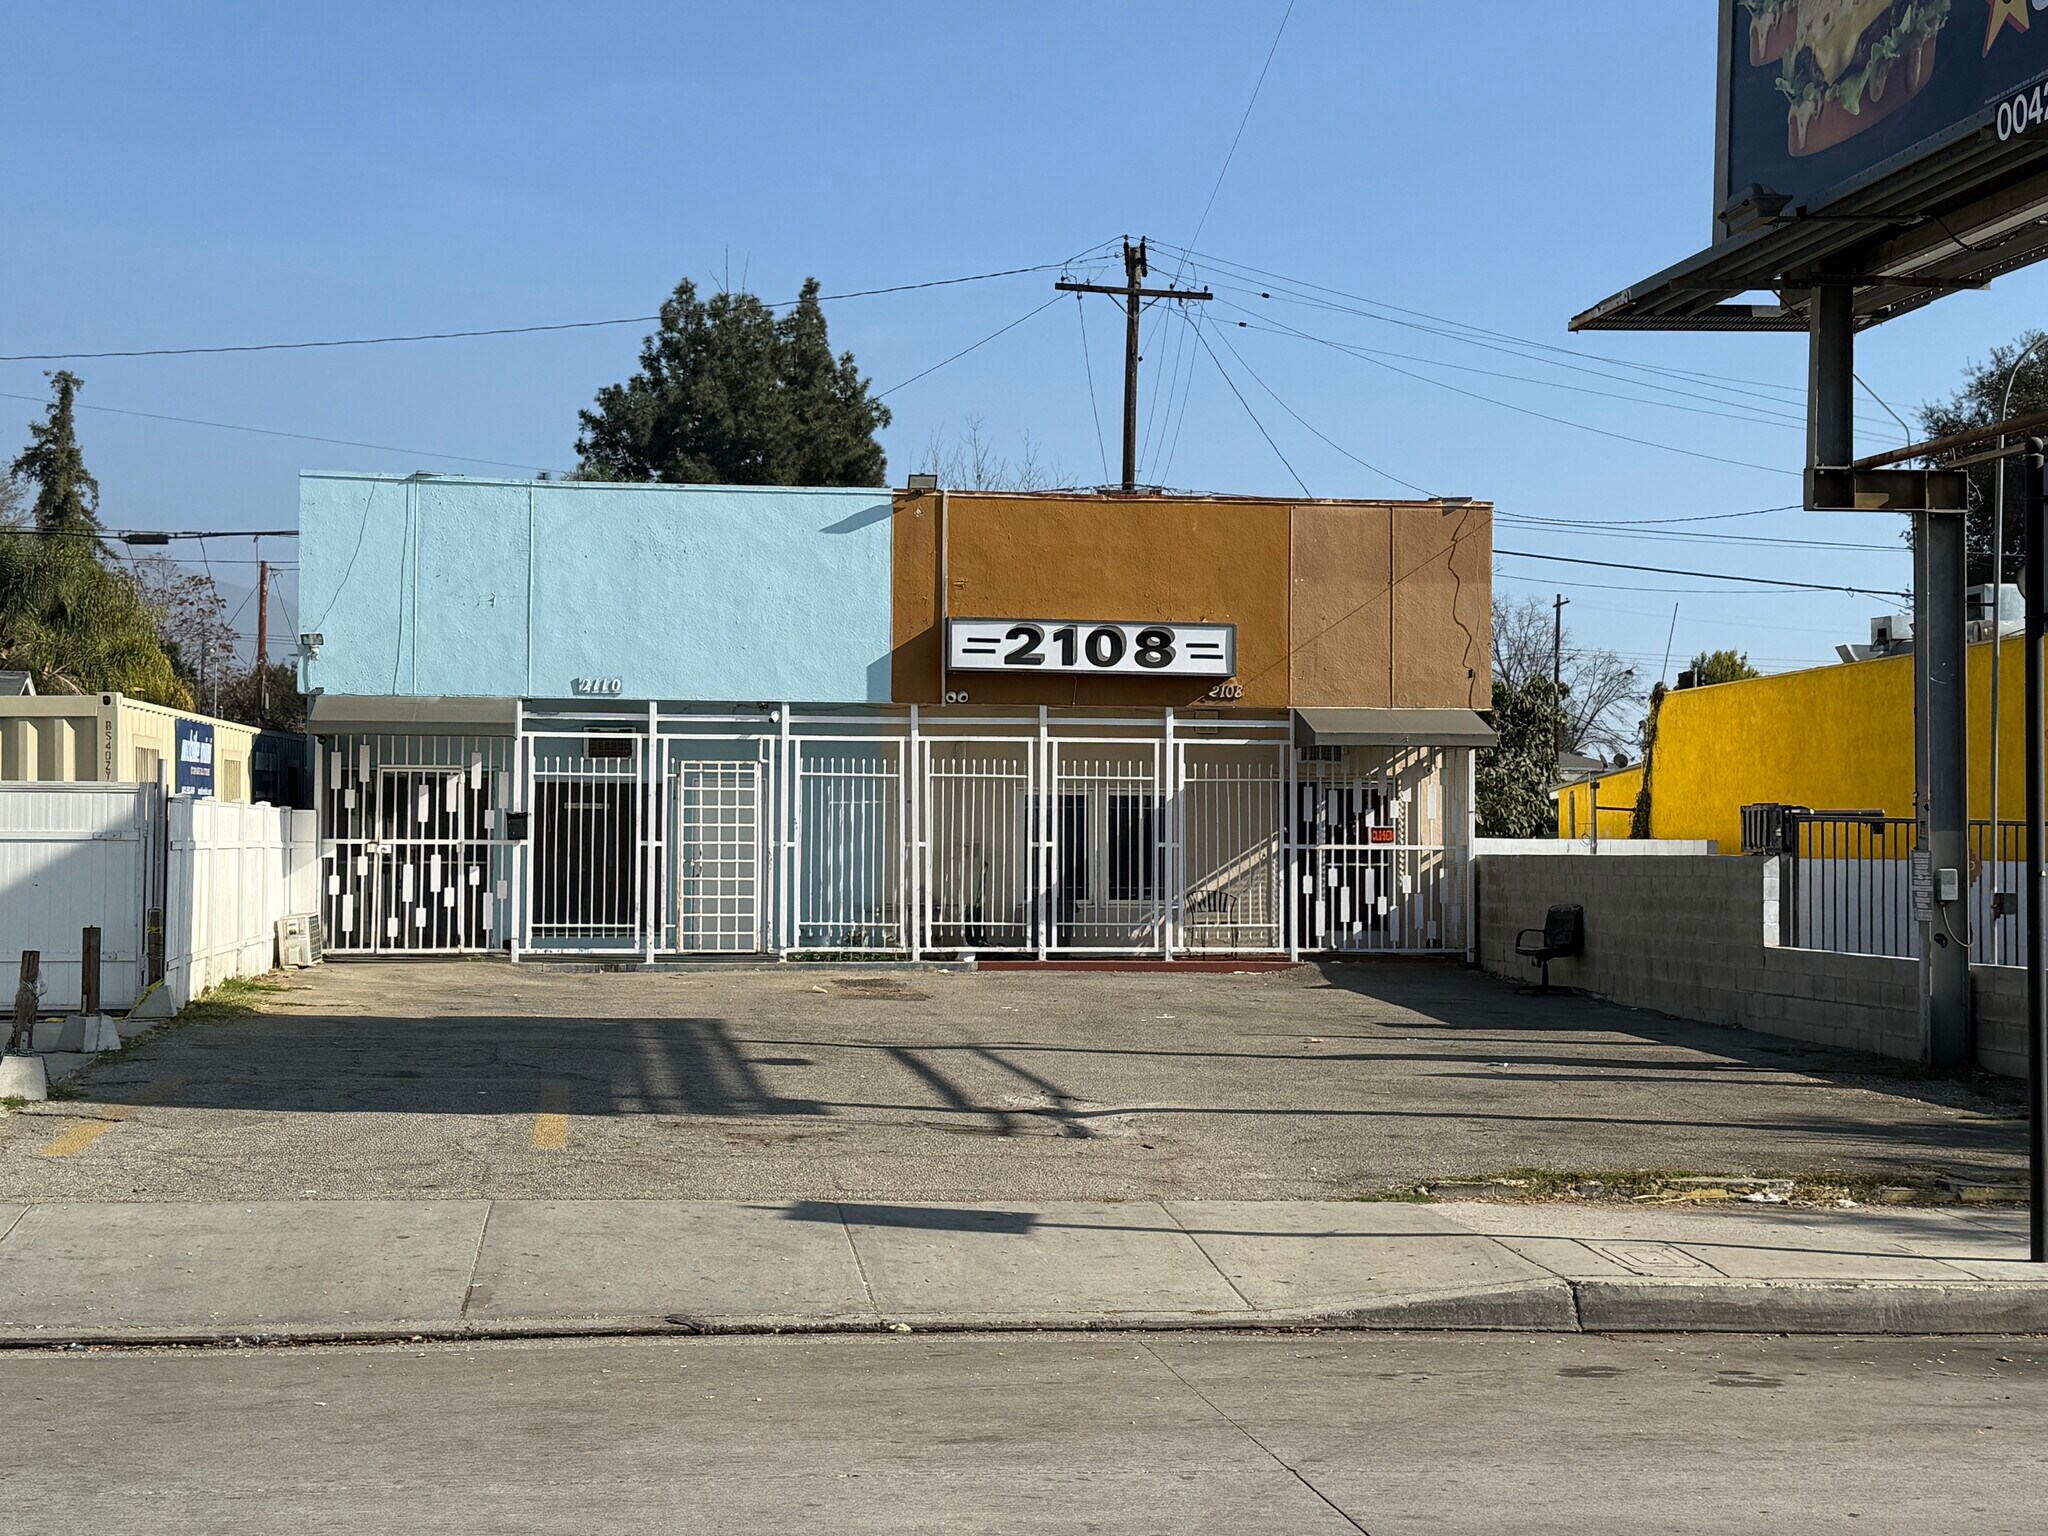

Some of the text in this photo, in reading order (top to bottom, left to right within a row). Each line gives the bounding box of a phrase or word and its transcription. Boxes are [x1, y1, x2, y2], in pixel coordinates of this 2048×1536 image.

[579, 678, 621, 692] 2110
[1208, 685, 1244, 698] 2108
[1372, 830, 1393, 841] CLOSED
